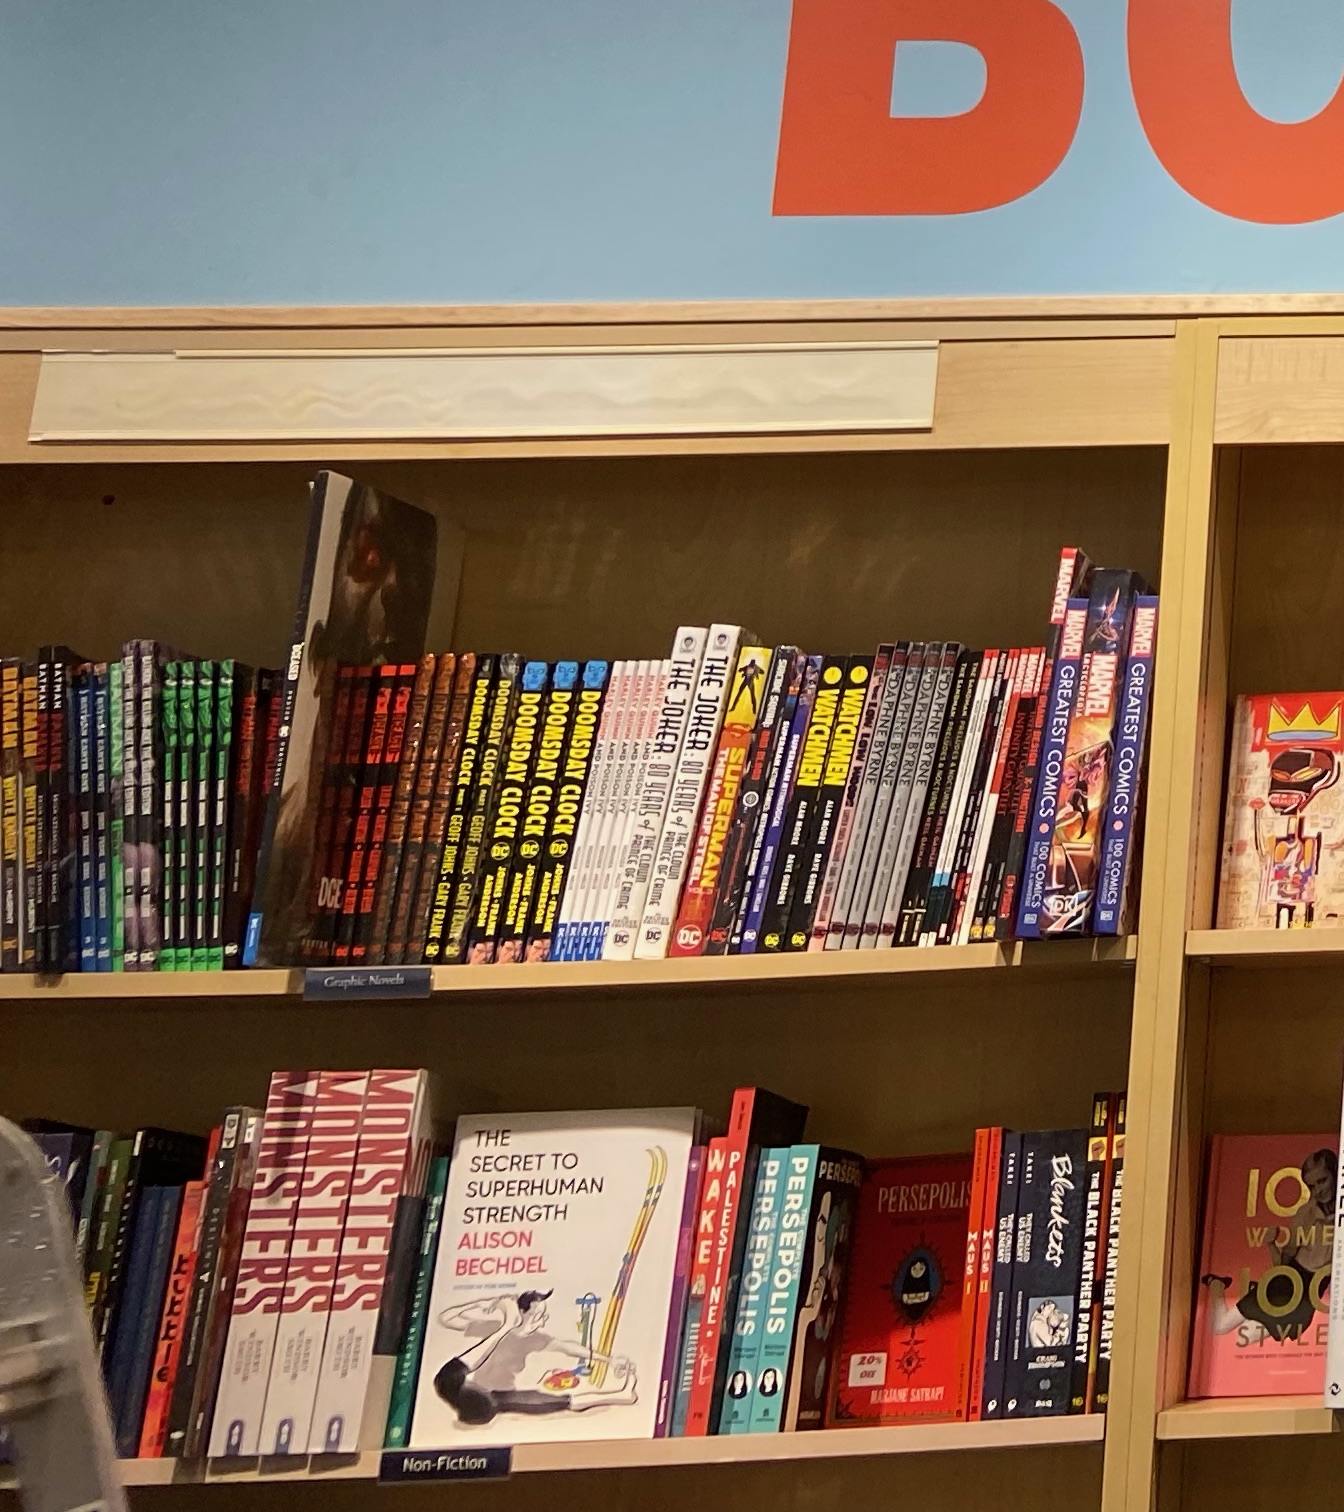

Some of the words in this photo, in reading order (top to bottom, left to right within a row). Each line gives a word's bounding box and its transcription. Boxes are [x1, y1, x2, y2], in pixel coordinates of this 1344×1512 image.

[1050, 558, 1075, 623] MARVEL
[1061, 609, 1086, 659] MARVEL
[1131, 608, 1156, 657] MARVEL
[38, 663, 47, 710] BATMAN
[53, 663, 62, 710] BATMAN
[667, 658, 696, 691] THE
[1085, 654, 1118, 717] MARVEL
[465, 678, 489, 746] DOOMSDAY
[488, 679, 512, 746] DOOMSDAY
[923, 677, 951, 737] DAPHNE
[1047, 665, 1075, 745] GREATEST
[1121, 663, 1146, 744] GREATEST
[505, 692, 541, 783] DOOMSDAY
[535, 691, 572, 782] DOOMSDAY
[797, 688, 840, 787] WATCHMEN
[823, 687, 867, 787] WATCHMEN
[915, 737, 938, 787] BYRNE
[457, 748, 476, 786] CLOCK
[479, 748, 497, 786] CLOCK
[1039, 749, 1065, 817] COMICS
[1112, 746, 1134, 815] COMICS
[493, 786, 523, 838] CLOCK
[523, 785, 553, 837] CLOCK
[703, 746, 747, 888] SUPERMAN
[1031, 863, 1047, 908] COMICS
[1106, 860, 1122, 905] COMICS
[324, 975, 366, 989] Graphic
[369, 973, 405, 986] Novels
[470, 1153, 546, 1174] SECRET
[551, 1152, 579, 1171] TO
[475, 1129, 512, 1148] THE
[233, 1071, 321, 1315] MONSTERS
[281, 1070, 370, 1314] MONSTERS
[330, 1069, 419, 1312] MONSTERS
[466, 1176, 604, 1199] SUPERHUMAN
[1044, 1153, 1076, 1268] Blankets
[1085, 1190, 1100, 1237] BLACK
[1109, 1188, 1122, 1235] BLACK
[463, 1204, 569, 1225] STRENGTH
[706, 1150, 741, 1326] PALESTINE
[1247, 1225, 1335, 1248] WOME
[455, 1257, 548, 1277] BECHDEL
[458, 1231, 533, 1251] ALISON
[735, 1159, 780, 1337] PERSEPOLIS
[766, 1156, 809, 1336] PERSEPOLIS
[1078, 1240, 1097, 1310] PANTHER
[1104, 1238, 1121, 1310] PANTHER
[1074, 1313, 1091, 1364] PARTY
[1099, 1311, 1114, 1361] PARTY
[1235, 1323, 1329, 1348] STYLE
[403, 1455, 487, 1473] Non-Fiction
